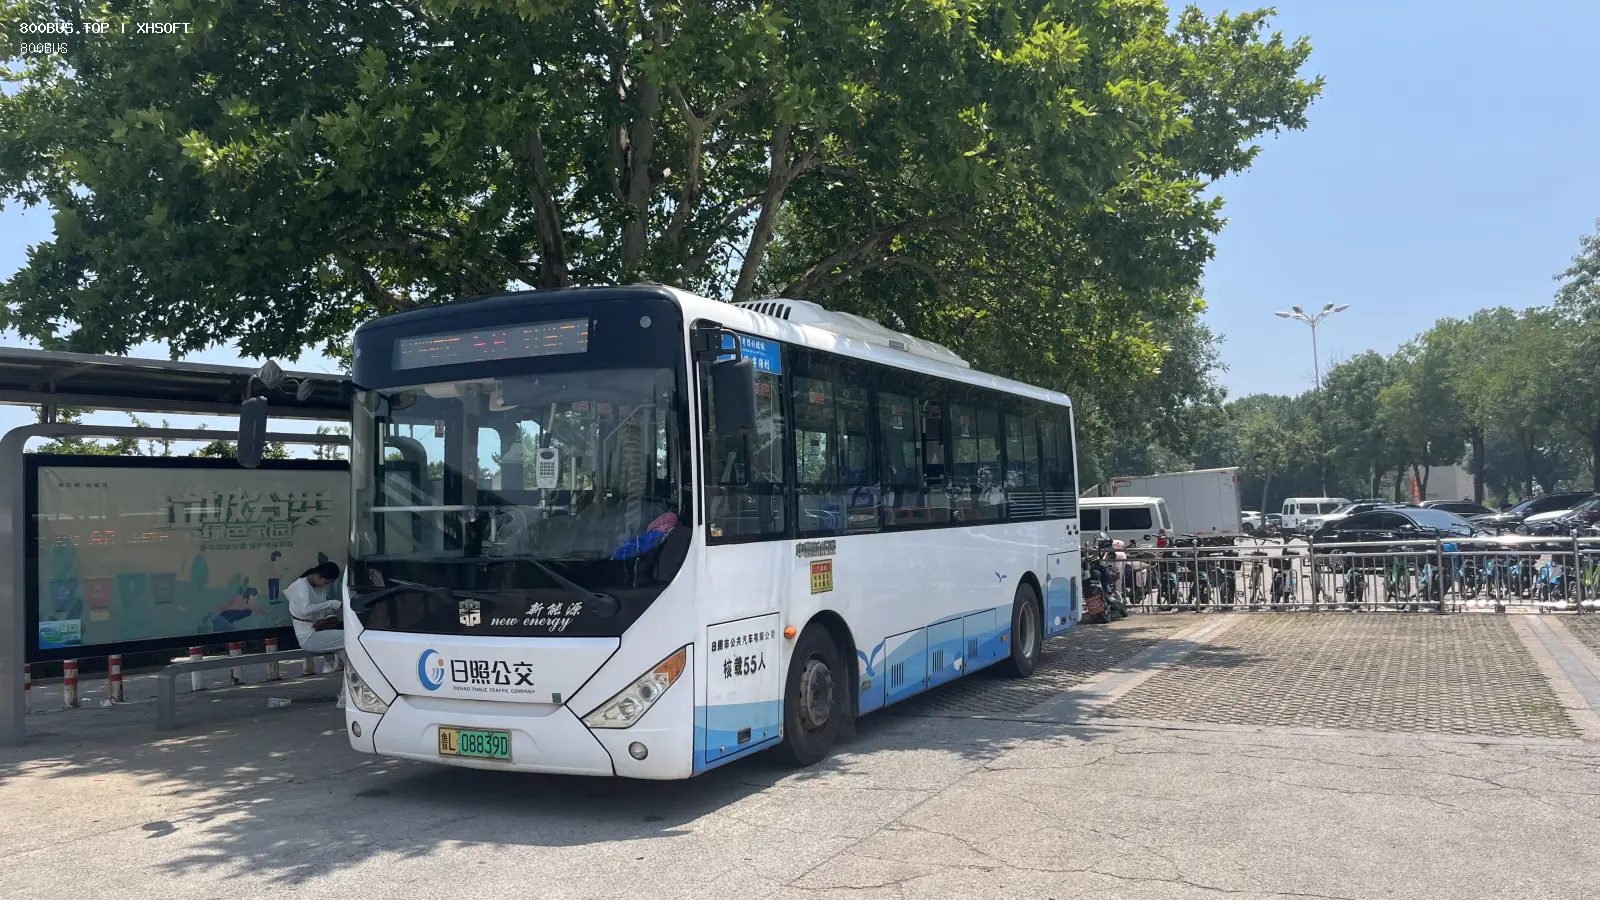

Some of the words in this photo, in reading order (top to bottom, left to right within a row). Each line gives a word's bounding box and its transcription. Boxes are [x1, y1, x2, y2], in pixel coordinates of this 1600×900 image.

[202, 521, 294, 541] 绿色家园
[525, 602, 582, 617] 新能源
[490, 617, 520, 627] new
[523, 617, 573, 632] energy
[711, 629, 776, 652] 日照市公共汽车有限公司
[450, 659, 535, 686] 日照公交
[723, 652, 766, 679] 核载55人
